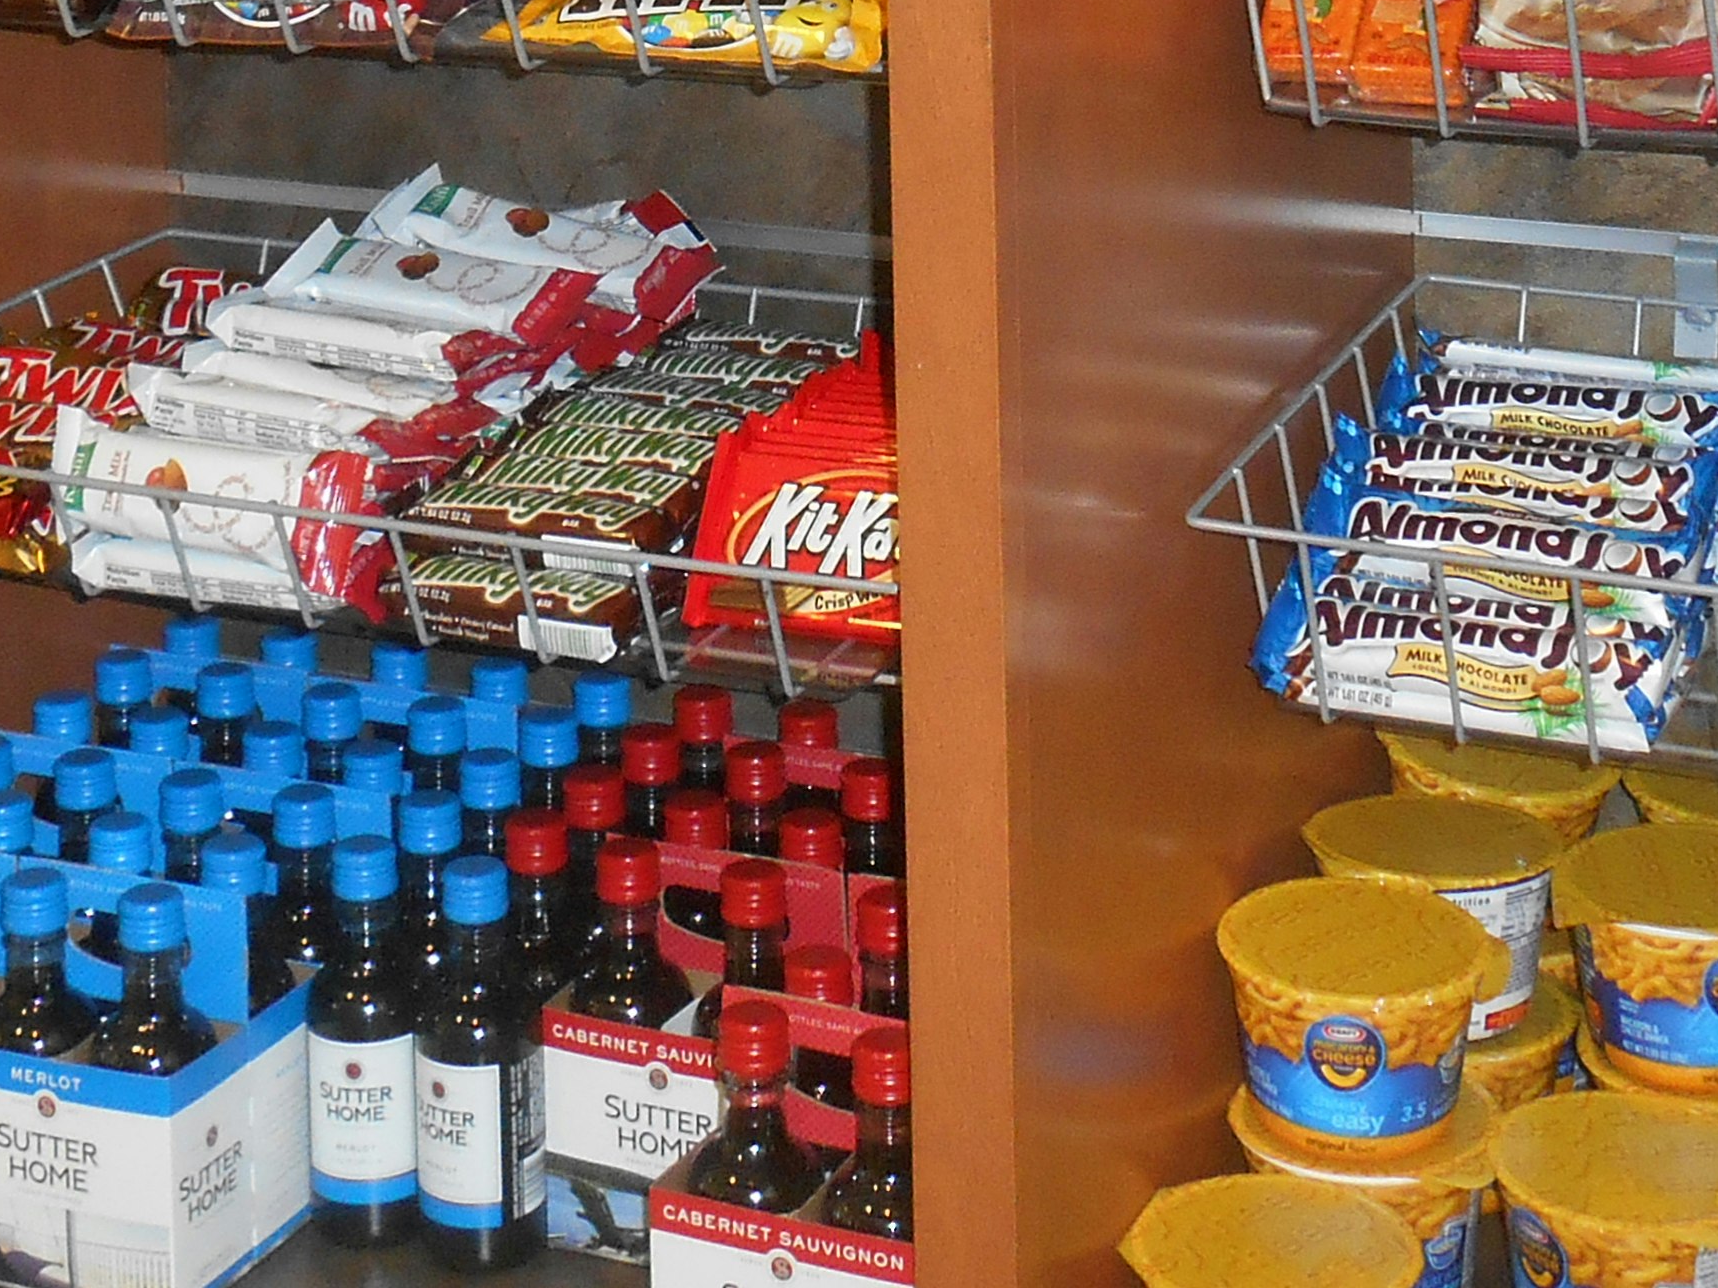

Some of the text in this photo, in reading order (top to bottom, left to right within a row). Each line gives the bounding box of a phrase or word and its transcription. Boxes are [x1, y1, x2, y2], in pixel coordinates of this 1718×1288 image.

[1417, 372, 1630, 412] Almond
[1500, 412, 1611, 438] MILK CHOCOLATE
[520, 425, 716, 476] Milky Way
[480, 450, 689, 509] Milky Way
[424, 482, 555, 525] Milky
[1349, 500, 1580, 561] Almond
[813, 591, 854, 612] Crisp
[1316, 600, 1541, 658] Almond
[1404, 647, 1529, 686] MILK HOCOLATE
[551, 1023, 717, 1068] CABERNET SAUVI
[9, 1066, 82, 1093] MERLOT
[319, 1080, 393, 1105] SUTTER
[326, 1100, 386, 1123] HOME
[602, 1093, 714, 1138] SUTTER
[1331, 1112, 1386, 1137] easy
[1400, 1101, 1427, 1123] 3.5
[8, 1155, 90, 1195] HOME
[178, 1139, 244, 1203] SUTTER
[186, 1173, 239, 1224] HOME
[661, 1203, 906, 1272] CABERNET SAUVIGNON
